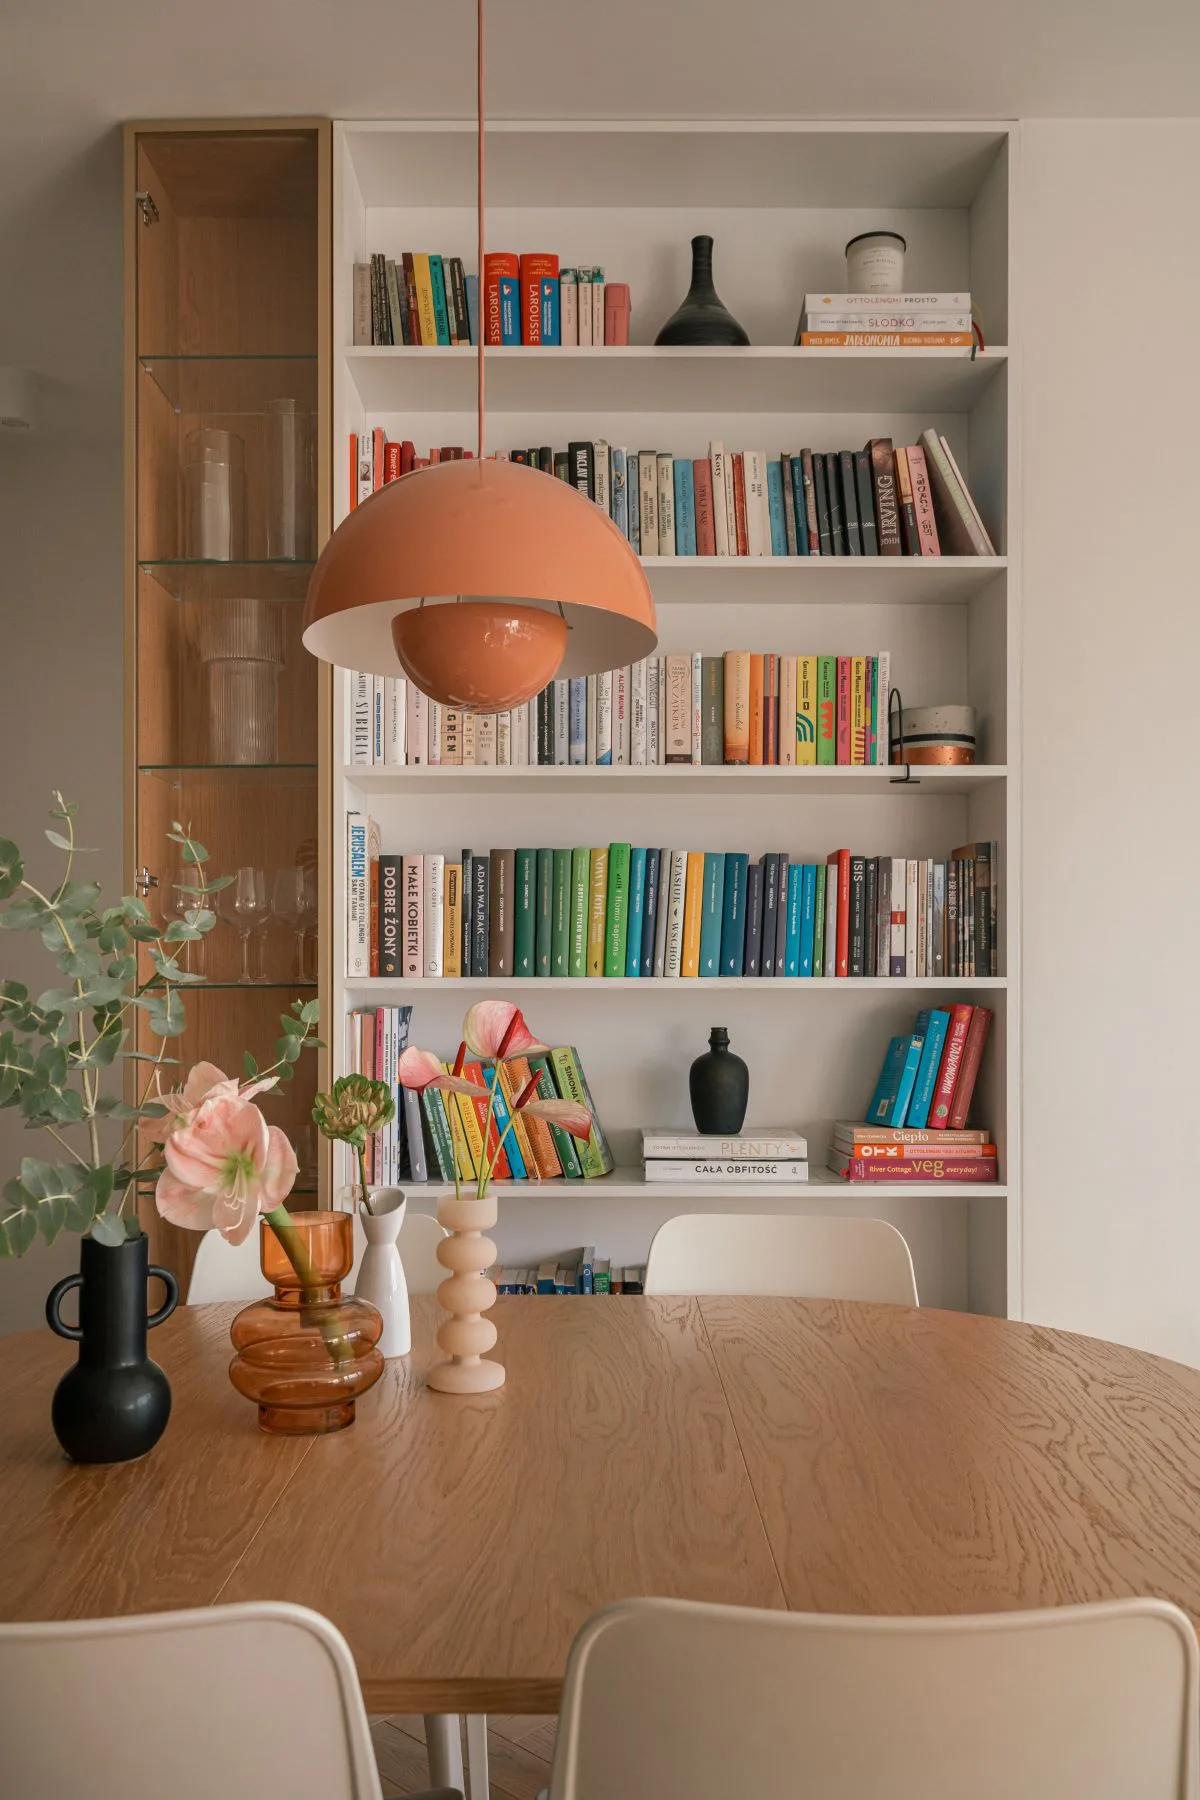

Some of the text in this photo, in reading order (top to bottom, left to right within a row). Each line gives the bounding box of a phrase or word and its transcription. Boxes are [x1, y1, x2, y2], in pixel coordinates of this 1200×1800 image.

[488, 284, 500, 342] LAROUSSE
[529, 284, 539, 342] LAROUSSE
[846, 296, 902, 304] OTTOLENGHI
[713, 453, 722, 478] Koty
[877, 475, 897, 535] IRVING
[649, 672, 658, 710] VONNEGUT
[355, 702, 369, 756] SYBERIA
[351, 825, 366, 944] JERUSALEM YOTAM OTTOLENGHI
[592, 854, 606, 888] Nowy
[853, 860, 863, 882] ISIS
[384, 867, 399, 957] DOBRE ŻONY
[407, 865, 418, 956] MAŁE KOBIETKI
[477, 894, 485, 935] WAJRAK
[611, 895, 623, 956] Homo sapiens
[669, 857, 683, 970] STASIUK WSCHÓD
[564, 1065, 579, 1099] SIMONA
[941, 1043, 962, 1095] JADŁONOMIA
[462, 1102, 475, 1128] DZIECKO
[721, 1142, 782, 1155] PLENTY
[861, 1145, 898, 1157] OTK
[892, 1131, 929, 1144] Ciepło
[695, 1164, 778, 1174] CAŁA OBFITOŚĆ
[887, 1166, 912, 1174] Cottage
[911, 1160, 944, 1178] veg
